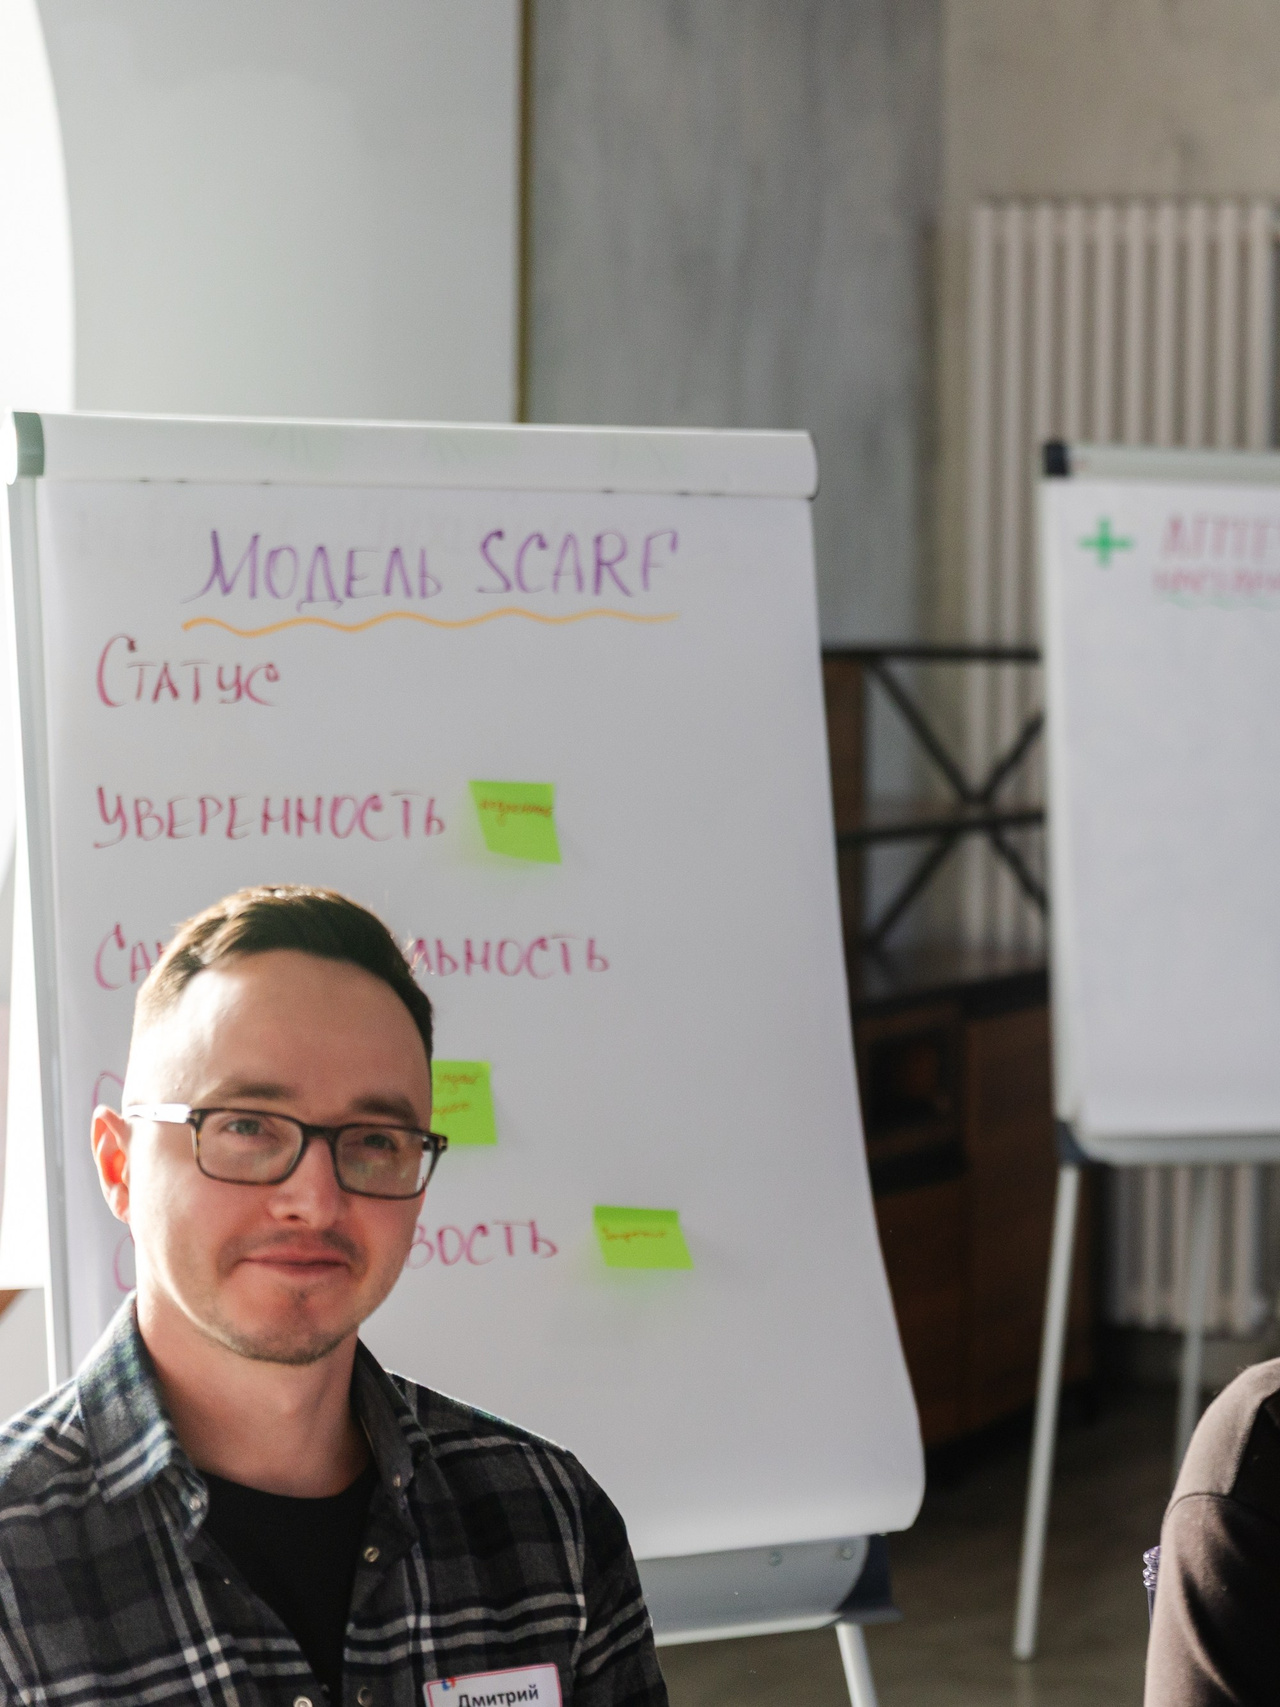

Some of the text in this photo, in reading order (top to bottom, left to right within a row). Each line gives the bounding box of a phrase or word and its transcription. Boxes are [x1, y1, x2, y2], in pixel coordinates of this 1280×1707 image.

[182, 528, 679, 612] МОДЕЛЬ SCARF
[96, 633, 281, 708] СТАТУС
[94, 786, 446, 849] УВЕРЕННОСТЬ
[458, 1684, 539, 1707] Дмитрий
